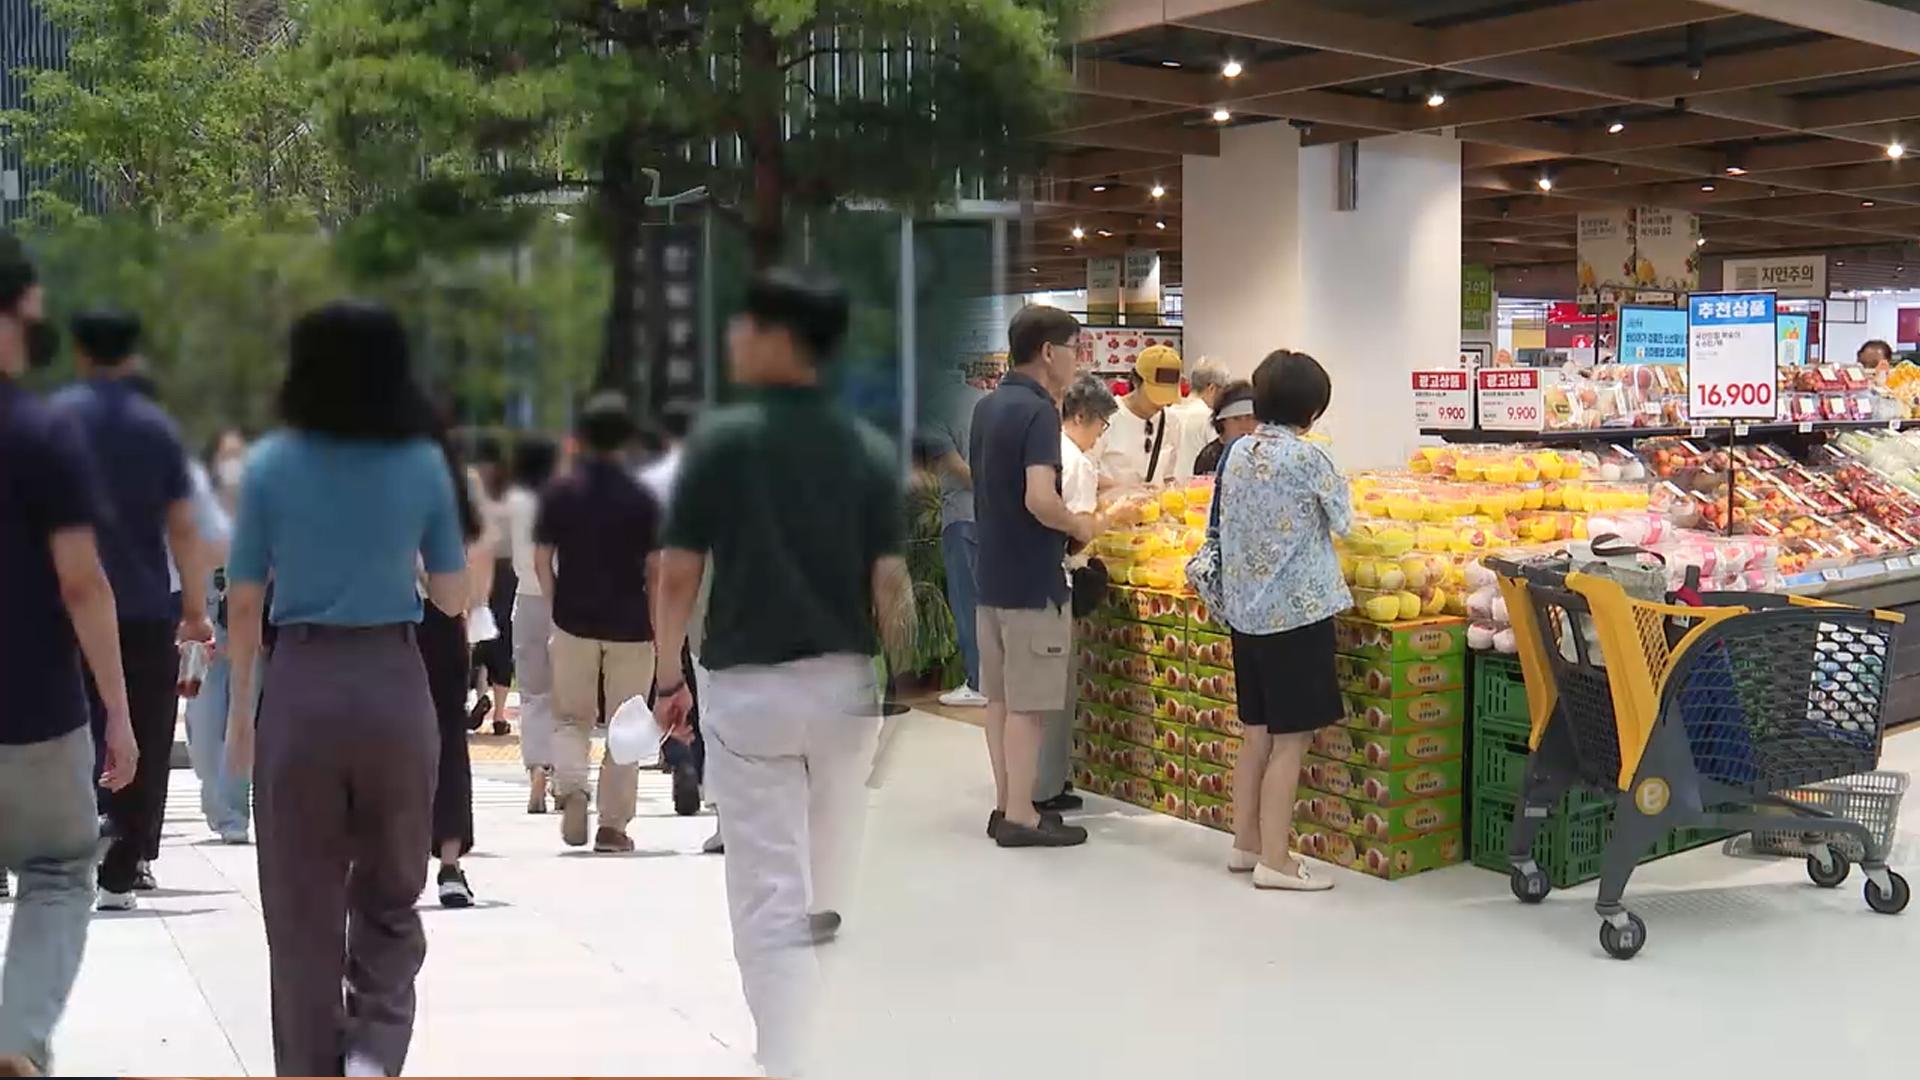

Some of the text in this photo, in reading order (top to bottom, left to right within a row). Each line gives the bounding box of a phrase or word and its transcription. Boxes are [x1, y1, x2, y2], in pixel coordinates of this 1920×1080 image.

[1698, 300, 1766, 319] 추천상품
[1419, 374, 1460, 388] 광고상품
[1486, 373, 1531, 387] 광고상품
[1697, 383, 1771, 407] 16,900
